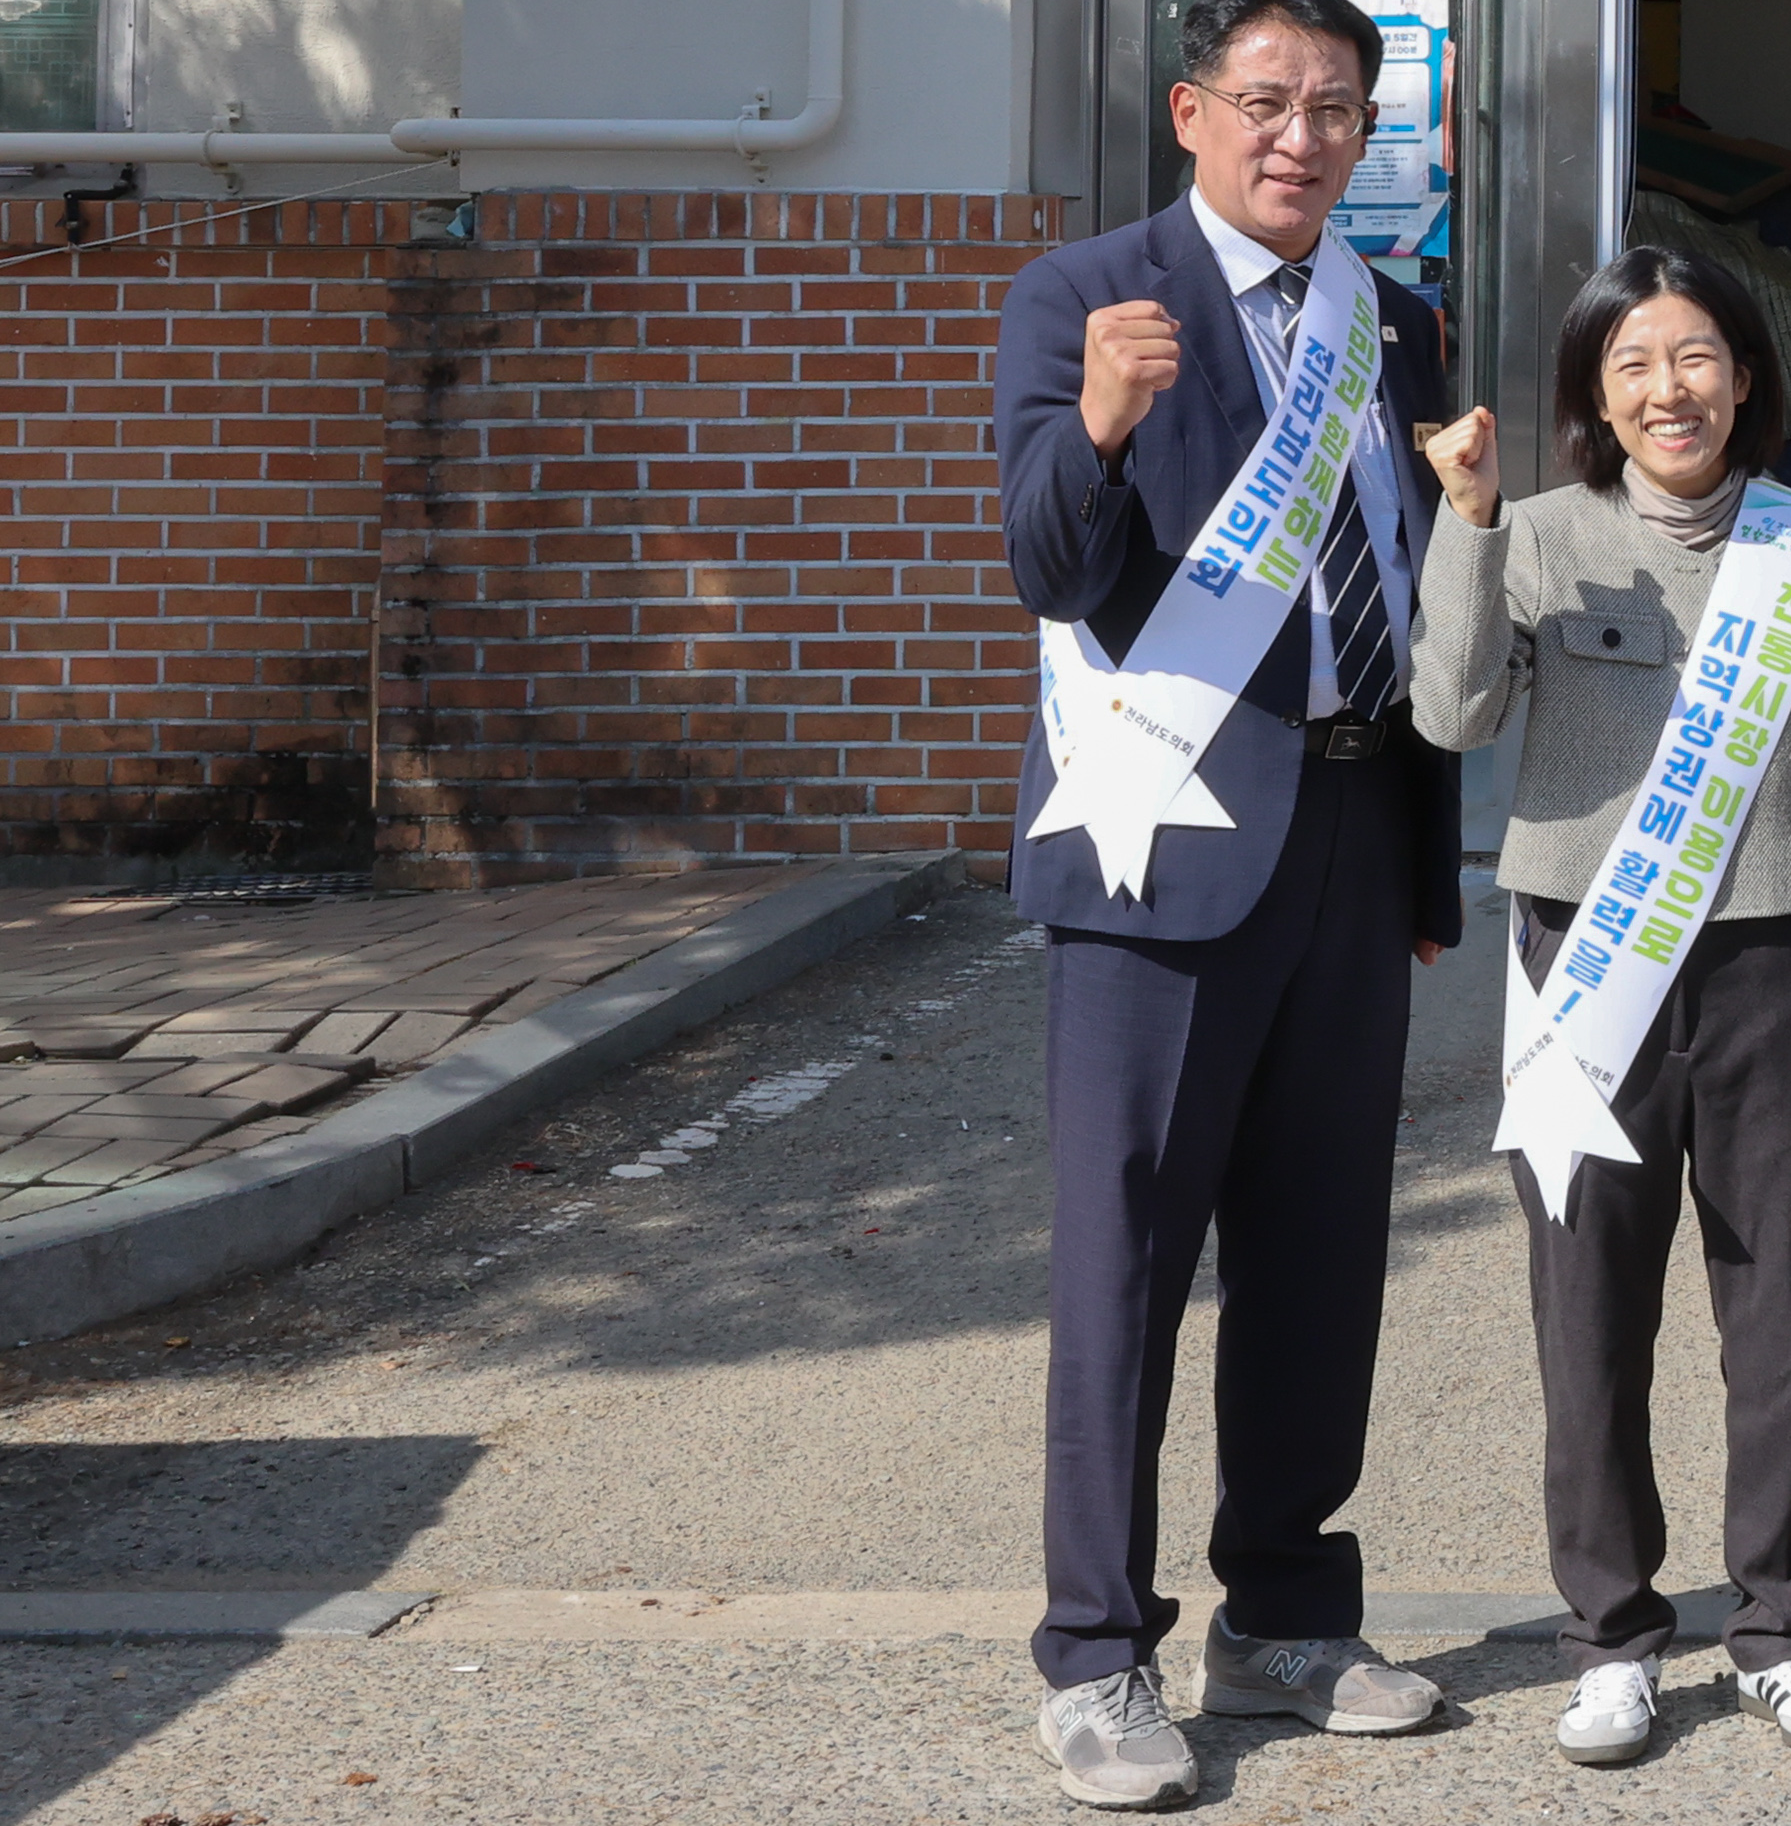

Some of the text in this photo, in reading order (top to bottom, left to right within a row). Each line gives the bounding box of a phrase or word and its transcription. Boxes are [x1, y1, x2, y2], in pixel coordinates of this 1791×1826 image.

[1186, 334, 1338, 600] 전라남도의회
[1256, 412, 1350, 593] 함께하는
[1123, 704, 1196, 758] 전라남도의회
[1552, 610, 1756, 1024] 지역상권에 활력을!
[1630, 774, 1748, 966] 이용으로
